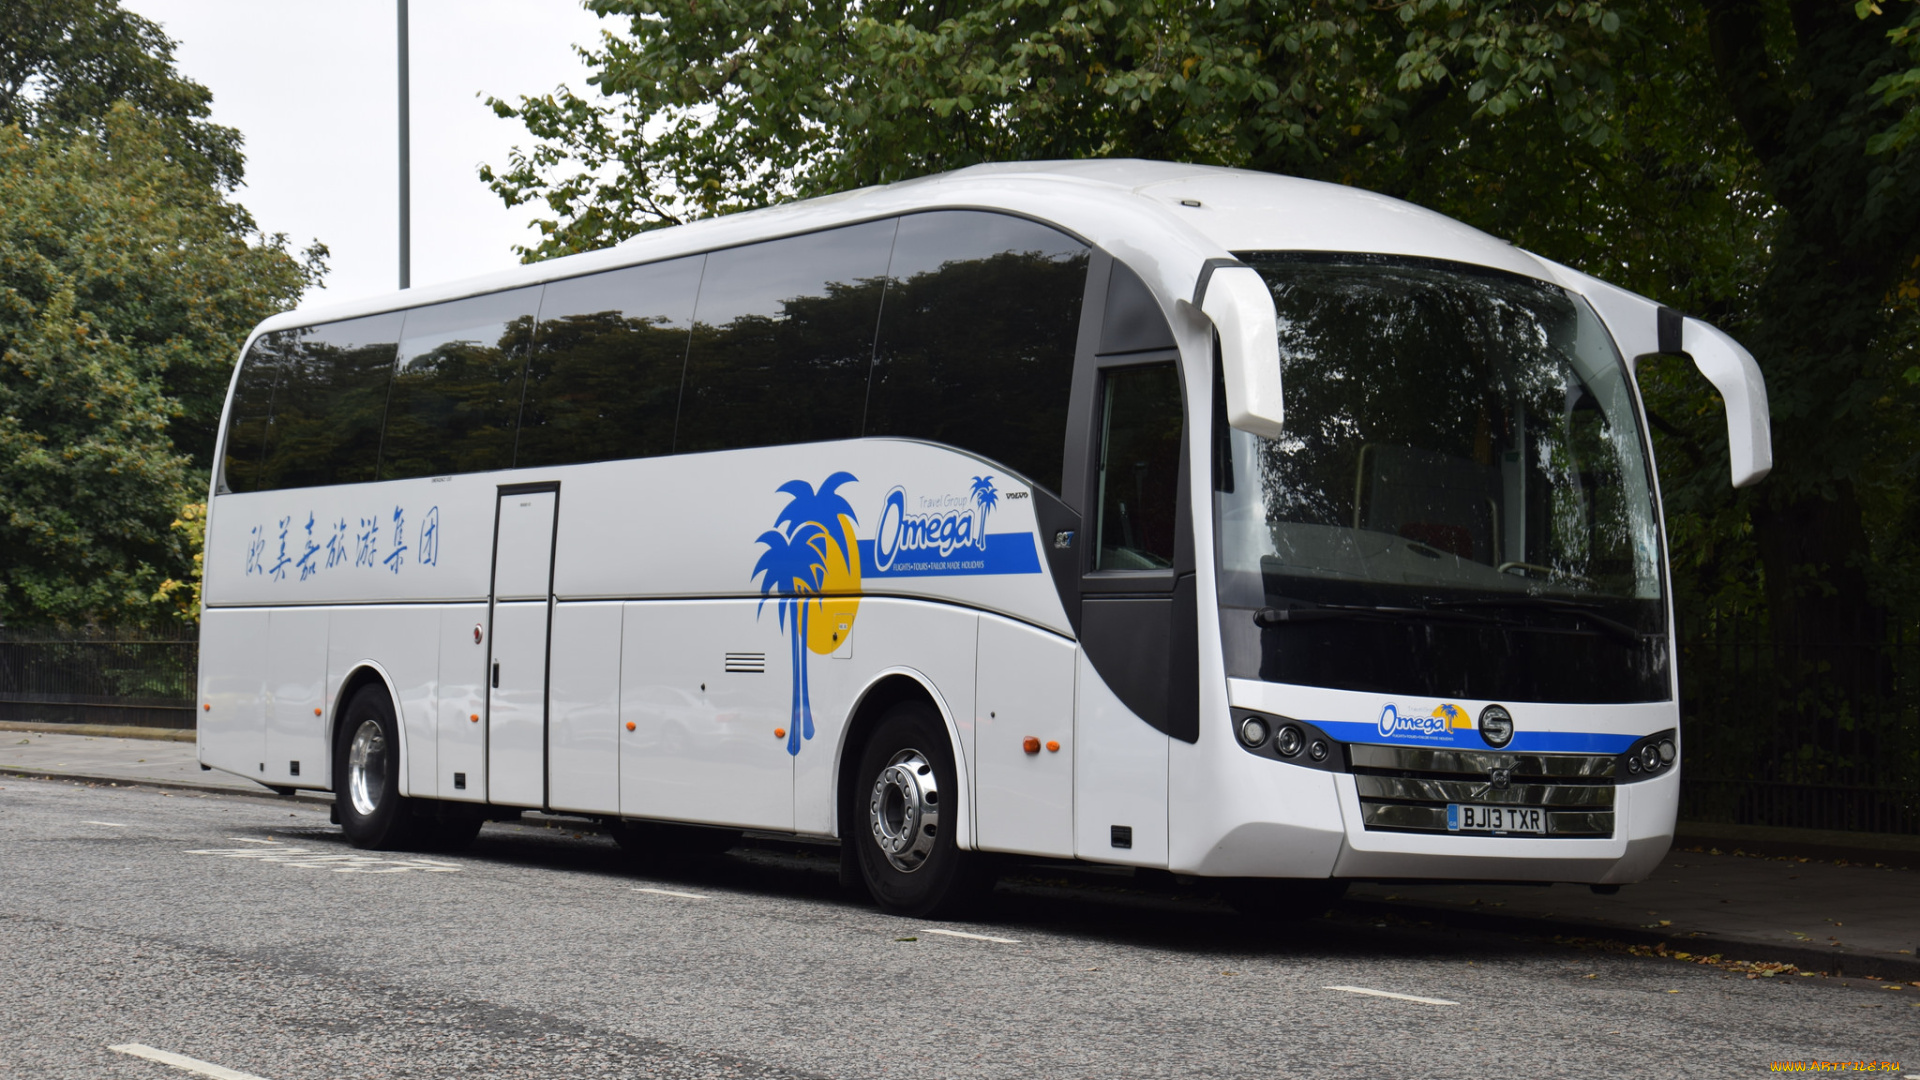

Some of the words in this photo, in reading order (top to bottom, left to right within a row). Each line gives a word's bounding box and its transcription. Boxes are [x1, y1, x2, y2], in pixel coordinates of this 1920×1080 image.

[919, 496, 943, 508] Travel
[943, 494, 968, 509] Group
[1006, 492, 1029, 500] VOLVO
[875, 487, 973, 572] Omega
[947, 561, 960, 570] MADE
[961, 560, 985, 569] HOLIDAYS
[1379, 704, 1444, 736] Omega
[1464, 807, 1502, 828] BJ13
[1507, 809, 1540, 830] TXR
